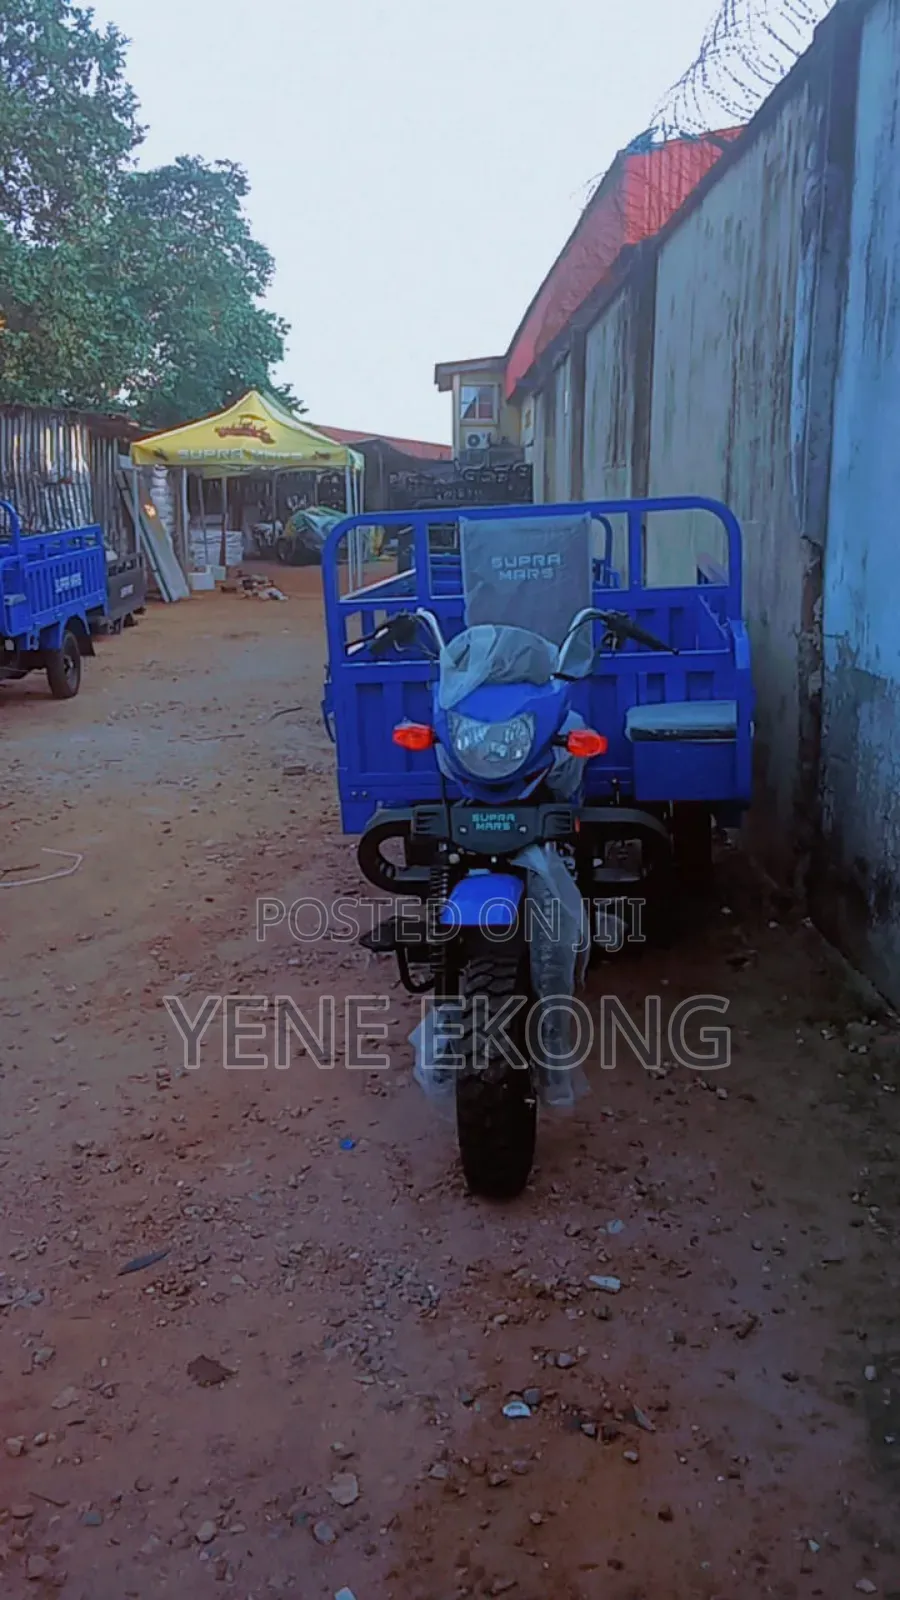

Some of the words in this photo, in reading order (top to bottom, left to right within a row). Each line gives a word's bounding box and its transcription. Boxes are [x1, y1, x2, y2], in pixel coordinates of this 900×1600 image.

[491, 554, 561, 568] SUPRA
[500, 567, 554, 580] MARS
[472, 813, 516, 822] SUPRA
[476, 822, 511, 831] MARS
